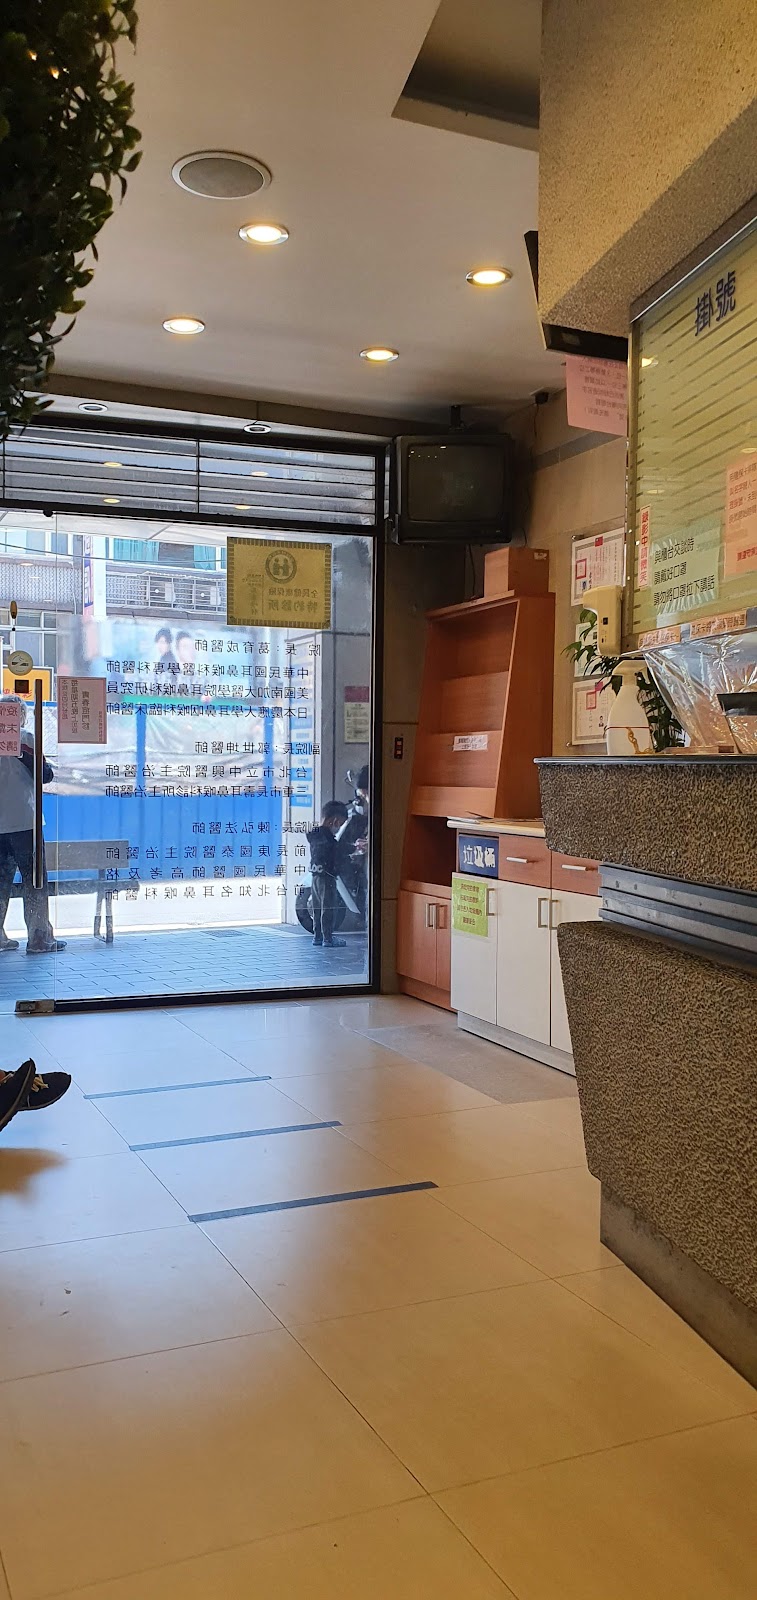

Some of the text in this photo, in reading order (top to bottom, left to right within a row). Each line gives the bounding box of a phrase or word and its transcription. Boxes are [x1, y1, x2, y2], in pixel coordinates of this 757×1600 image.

[694, 270, 736, 337] 掛號
[654, 537, 695, 565] 與櫃台交談時
[654, 561, 688, 585] 請戴好口罩
[653, 574, 715, 606] 請勿將口罩拉下講話
